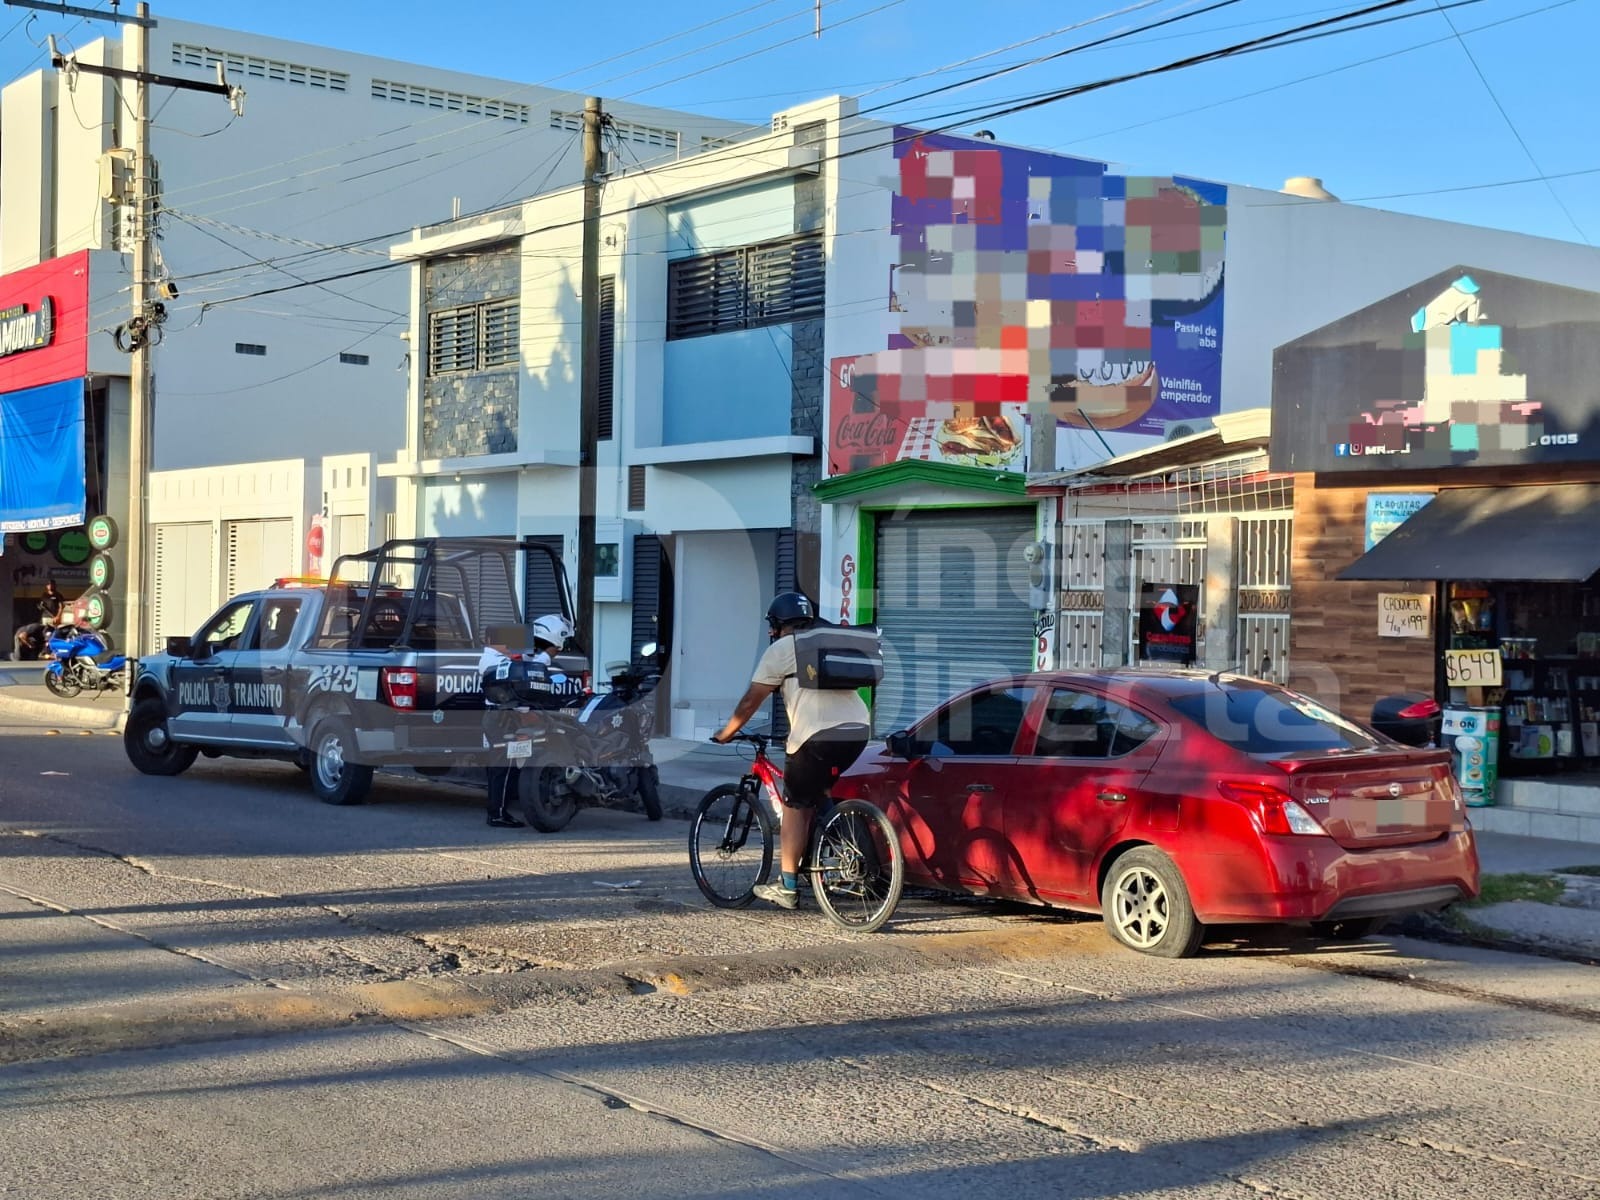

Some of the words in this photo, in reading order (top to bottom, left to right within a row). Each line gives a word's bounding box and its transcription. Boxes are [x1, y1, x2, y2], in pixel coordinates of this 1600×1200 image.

[1174, 320, 1203, 334] Pastel
[1205, 325, 1217, 337] de
[1199, 337, 1217, 349] aba
[1160, 391, 1212, 404] emperador
[1383, 597, 1422, 611] CROQUETA
[1446, 651, 1496, 681] $649
[321, 664, 358, 693] 325
[436, 671, 484, 694] POLICÍA
[179, 678, 211, 706] POLICÍA
[234, 682, 283, 708] TRANSITO
[1303, 796, 1330, 805] VERS
